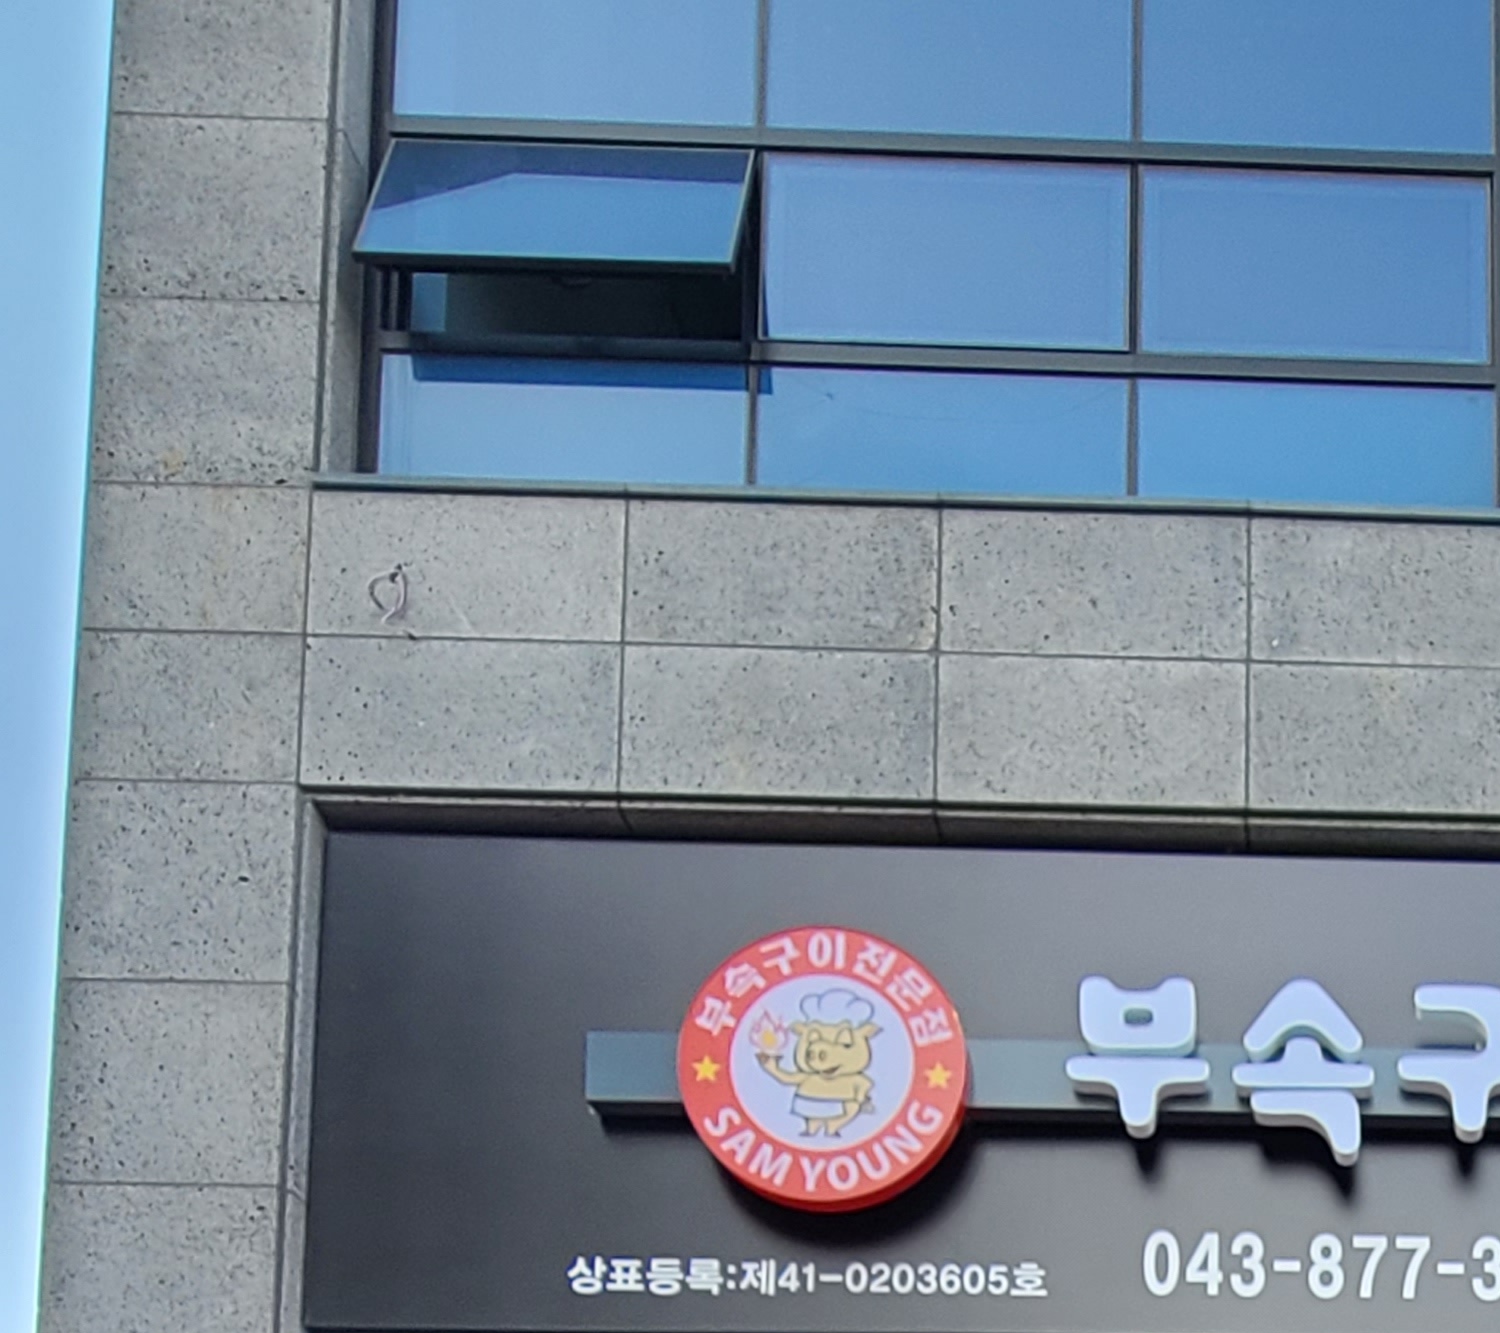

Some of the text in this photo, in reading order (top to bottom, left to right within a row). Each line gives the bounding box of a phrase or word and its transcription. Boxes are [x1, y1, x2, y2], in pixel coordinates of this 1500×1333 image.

[694, 931, 954, 1048] 부속구이전문점
[703, 1099, 943, 1192] SAM YOUNG
[567, 1255, 1048, 1297] 상표등록:제41-0203605호
